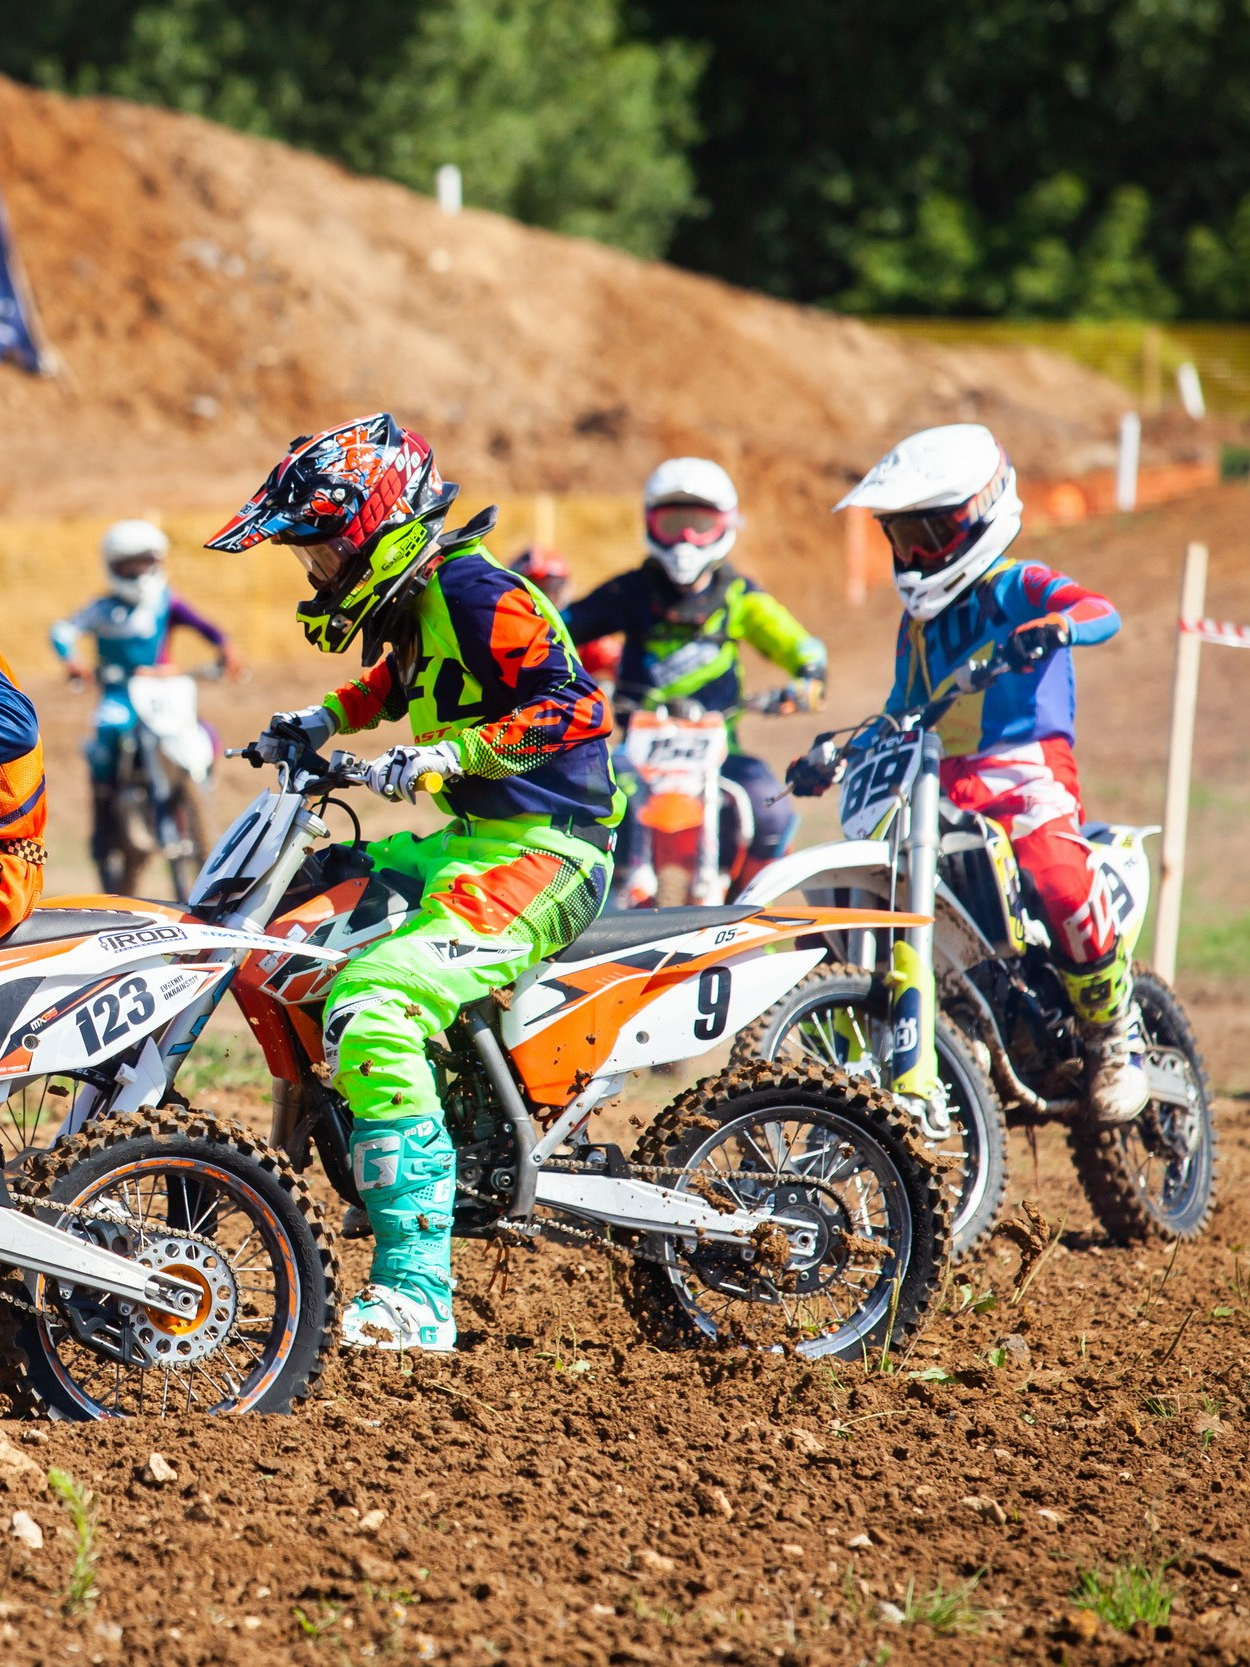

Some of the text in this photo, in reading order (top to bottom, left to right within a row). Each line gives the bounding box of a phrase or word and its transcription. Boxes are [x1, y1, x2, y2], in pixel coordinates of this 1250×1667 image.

[842, 748, 914, 827] 89
[75, 976, 156, 1057] 123
[693, 966, 732, 1041] 9
